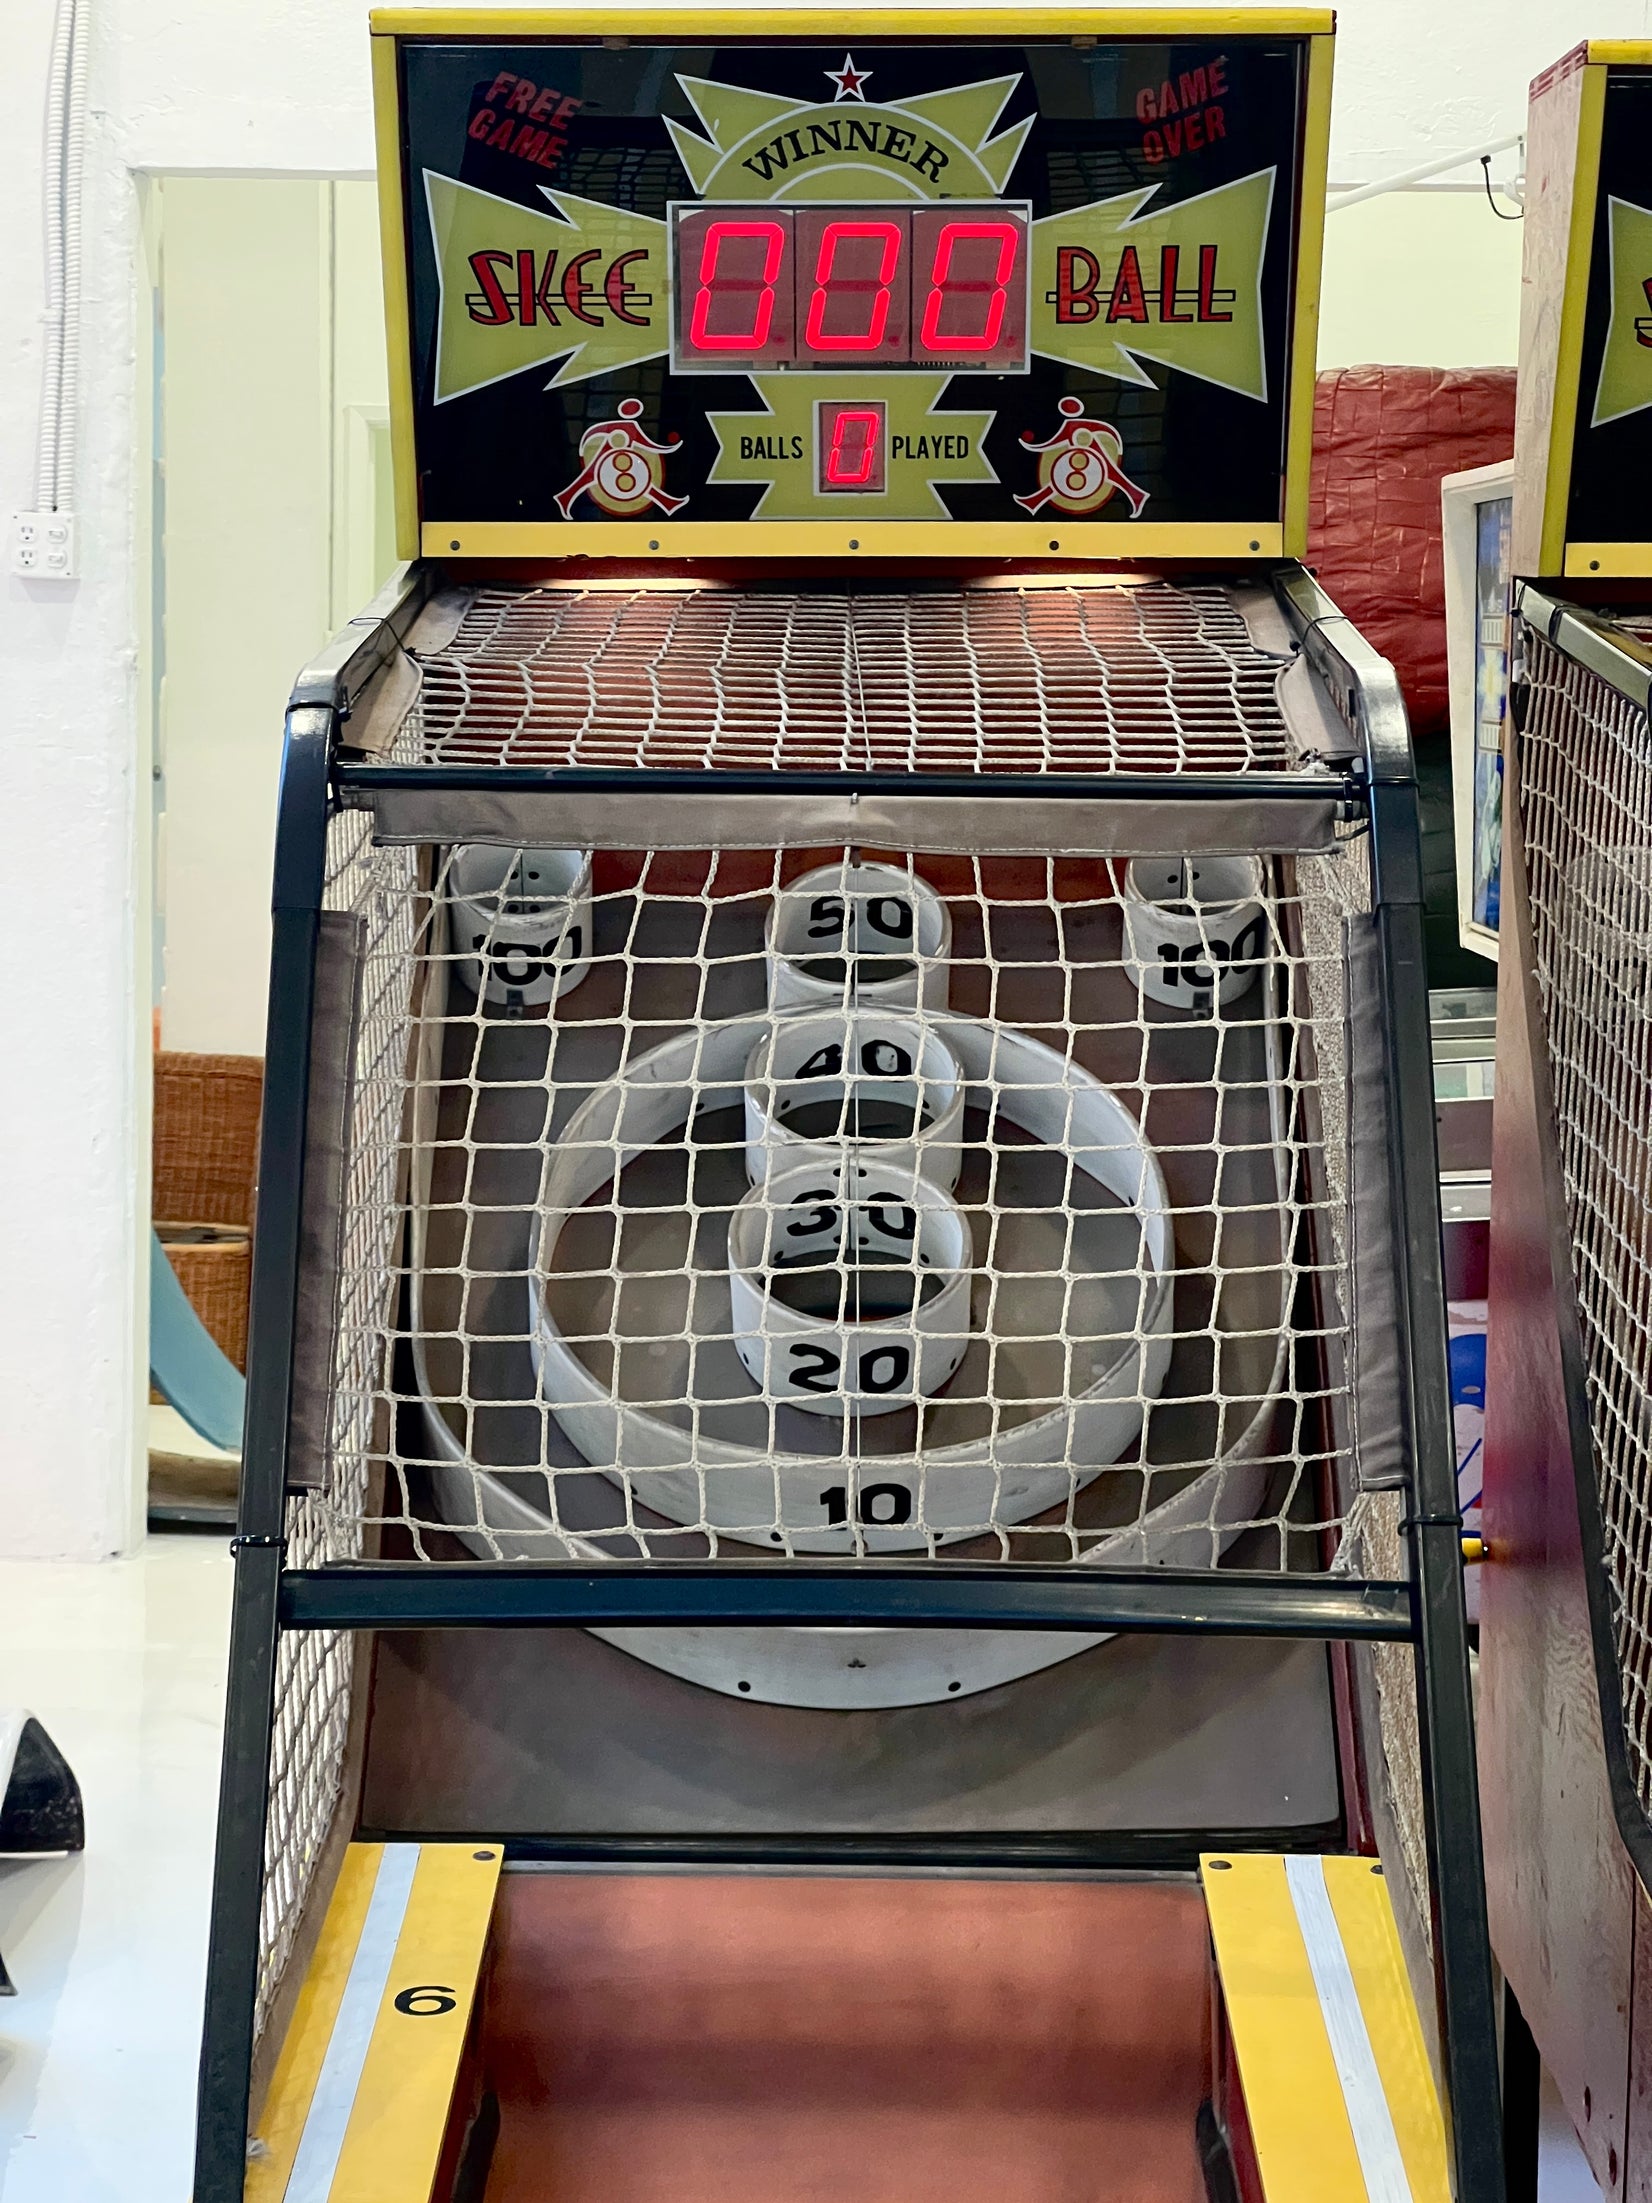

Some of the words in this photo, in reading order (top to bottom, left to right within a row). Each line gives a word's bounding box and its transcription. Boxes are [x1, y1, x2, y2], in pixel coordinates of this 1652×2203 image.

[482, 71, 584, 130] FREE
[1136, 56, 1230, 125] GAME
[468, 108, 568, 170] GAME
[742, 118, 950, 183] WINNER
[1143, 106, 1227, 166] OVER
[465, 249, 652, 327] SKEE
[1045, 245, 1236, 324] BALL
[740, 436, 804, 460] BALLS
[892, 435, 969, 460] PLAYED
[826, 411, 880, 484] 0
[808, 896, 913, 940] 50
[1157, 917, 1264, 988] 100
[795, 1039, 912, 1079] 40
[786, 1190, 917, 1240] 30
[788, 1343, 910, 1394] 20
[819, 1483, 912, 1531] 10
[394, 1985, 457, 2016] 6
